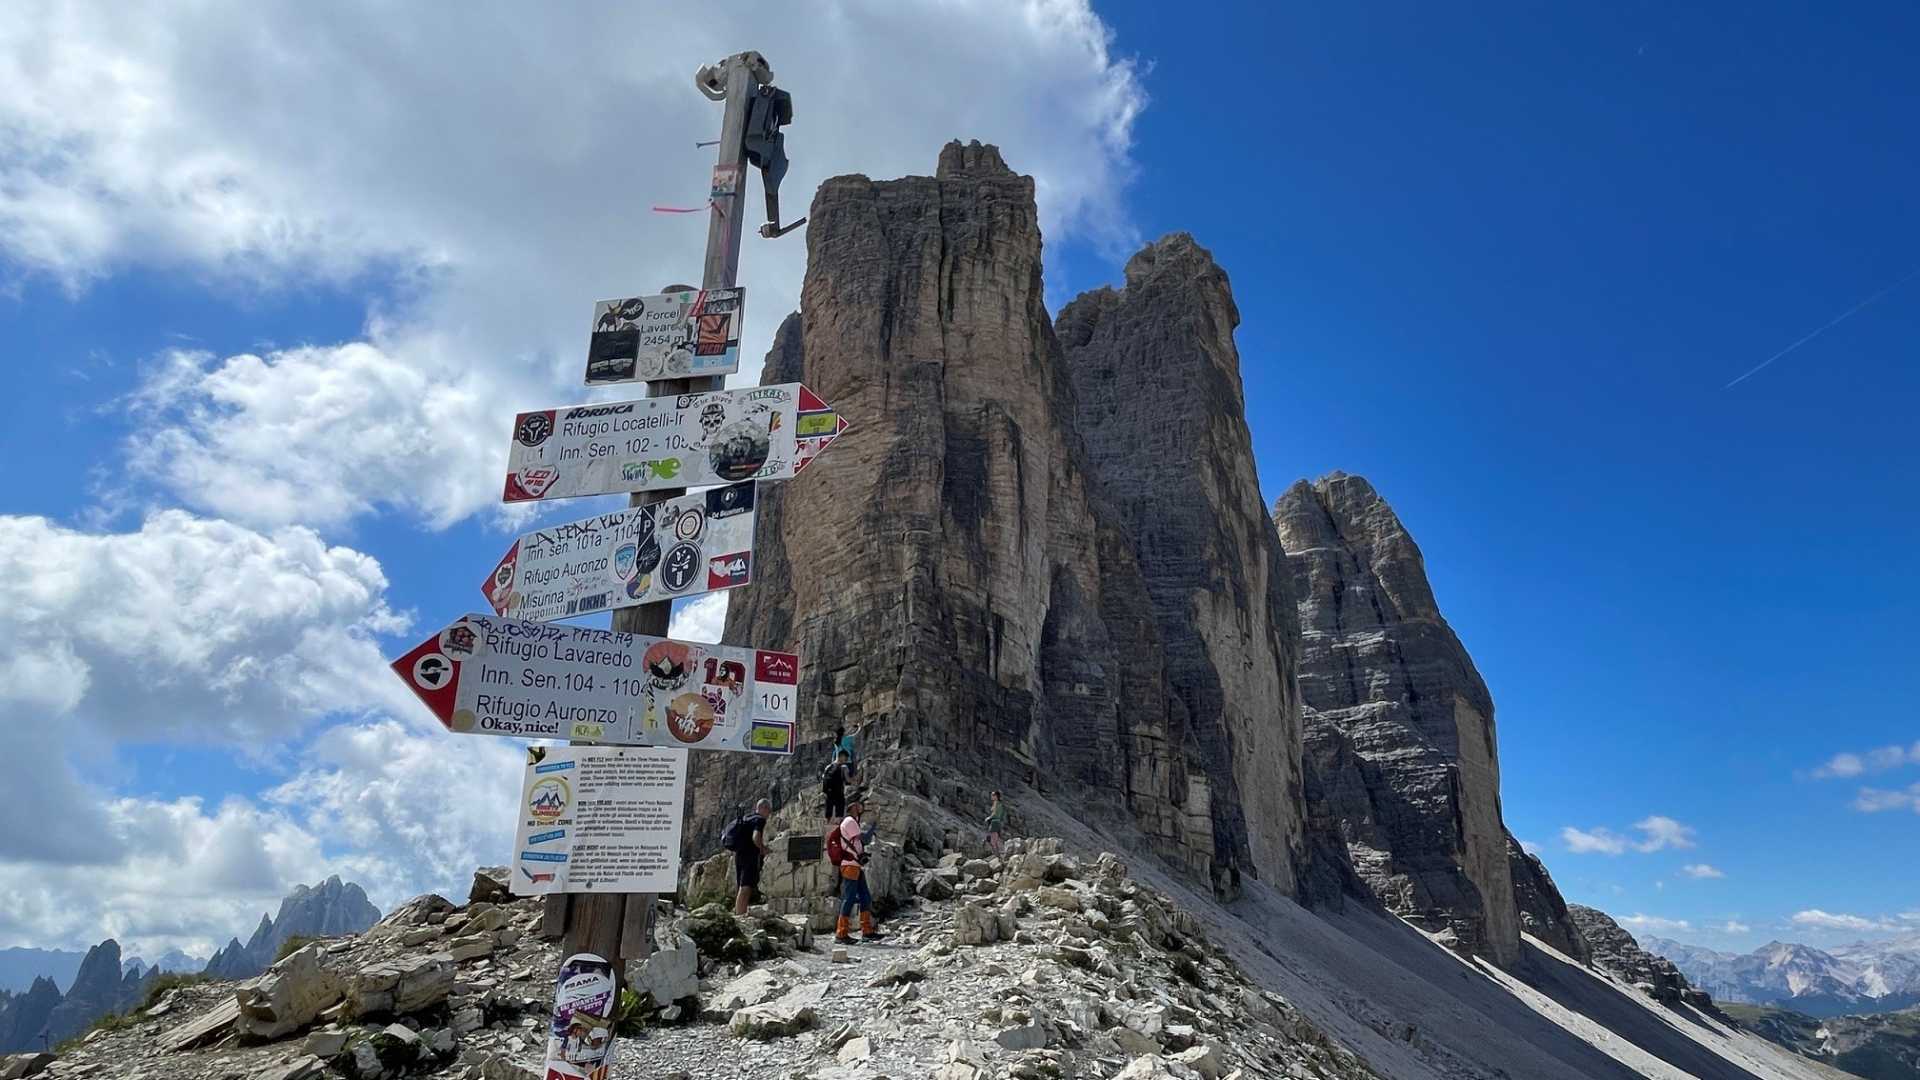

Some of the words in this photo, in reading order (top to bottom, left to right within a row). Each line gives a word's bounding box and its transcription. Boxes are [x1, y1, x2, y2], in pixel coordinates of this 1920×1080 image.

[643, 334, 671, 346] 2454
[565, 404, 634, 420] NORDICA
[563, 420, 609, 438] Rifugio
[560, 446, 583, 461] Inn.
[588, 442, 618, 457] Sen.
[625, 437, 650, 454] 102
[576, 534, 602, 550] 101a
[614, 523, 640, 542] 1104
[524, 568, 560, 585] Rifugio
[562, 558, 608, 577] Auronzo
[486, 633, 548, 662] Rifugio
[554, 640, 632, 668] Lavaredo
[481, 664, 513, 685] Inn.
[476, 694, 541, 721] Rifugio
[544, 701, 617, 723] Auronzo
[762, 692, 789, 711] 101
[481, 716, 523, 734] Okay,
[525, 720, 559, 733] nice!
